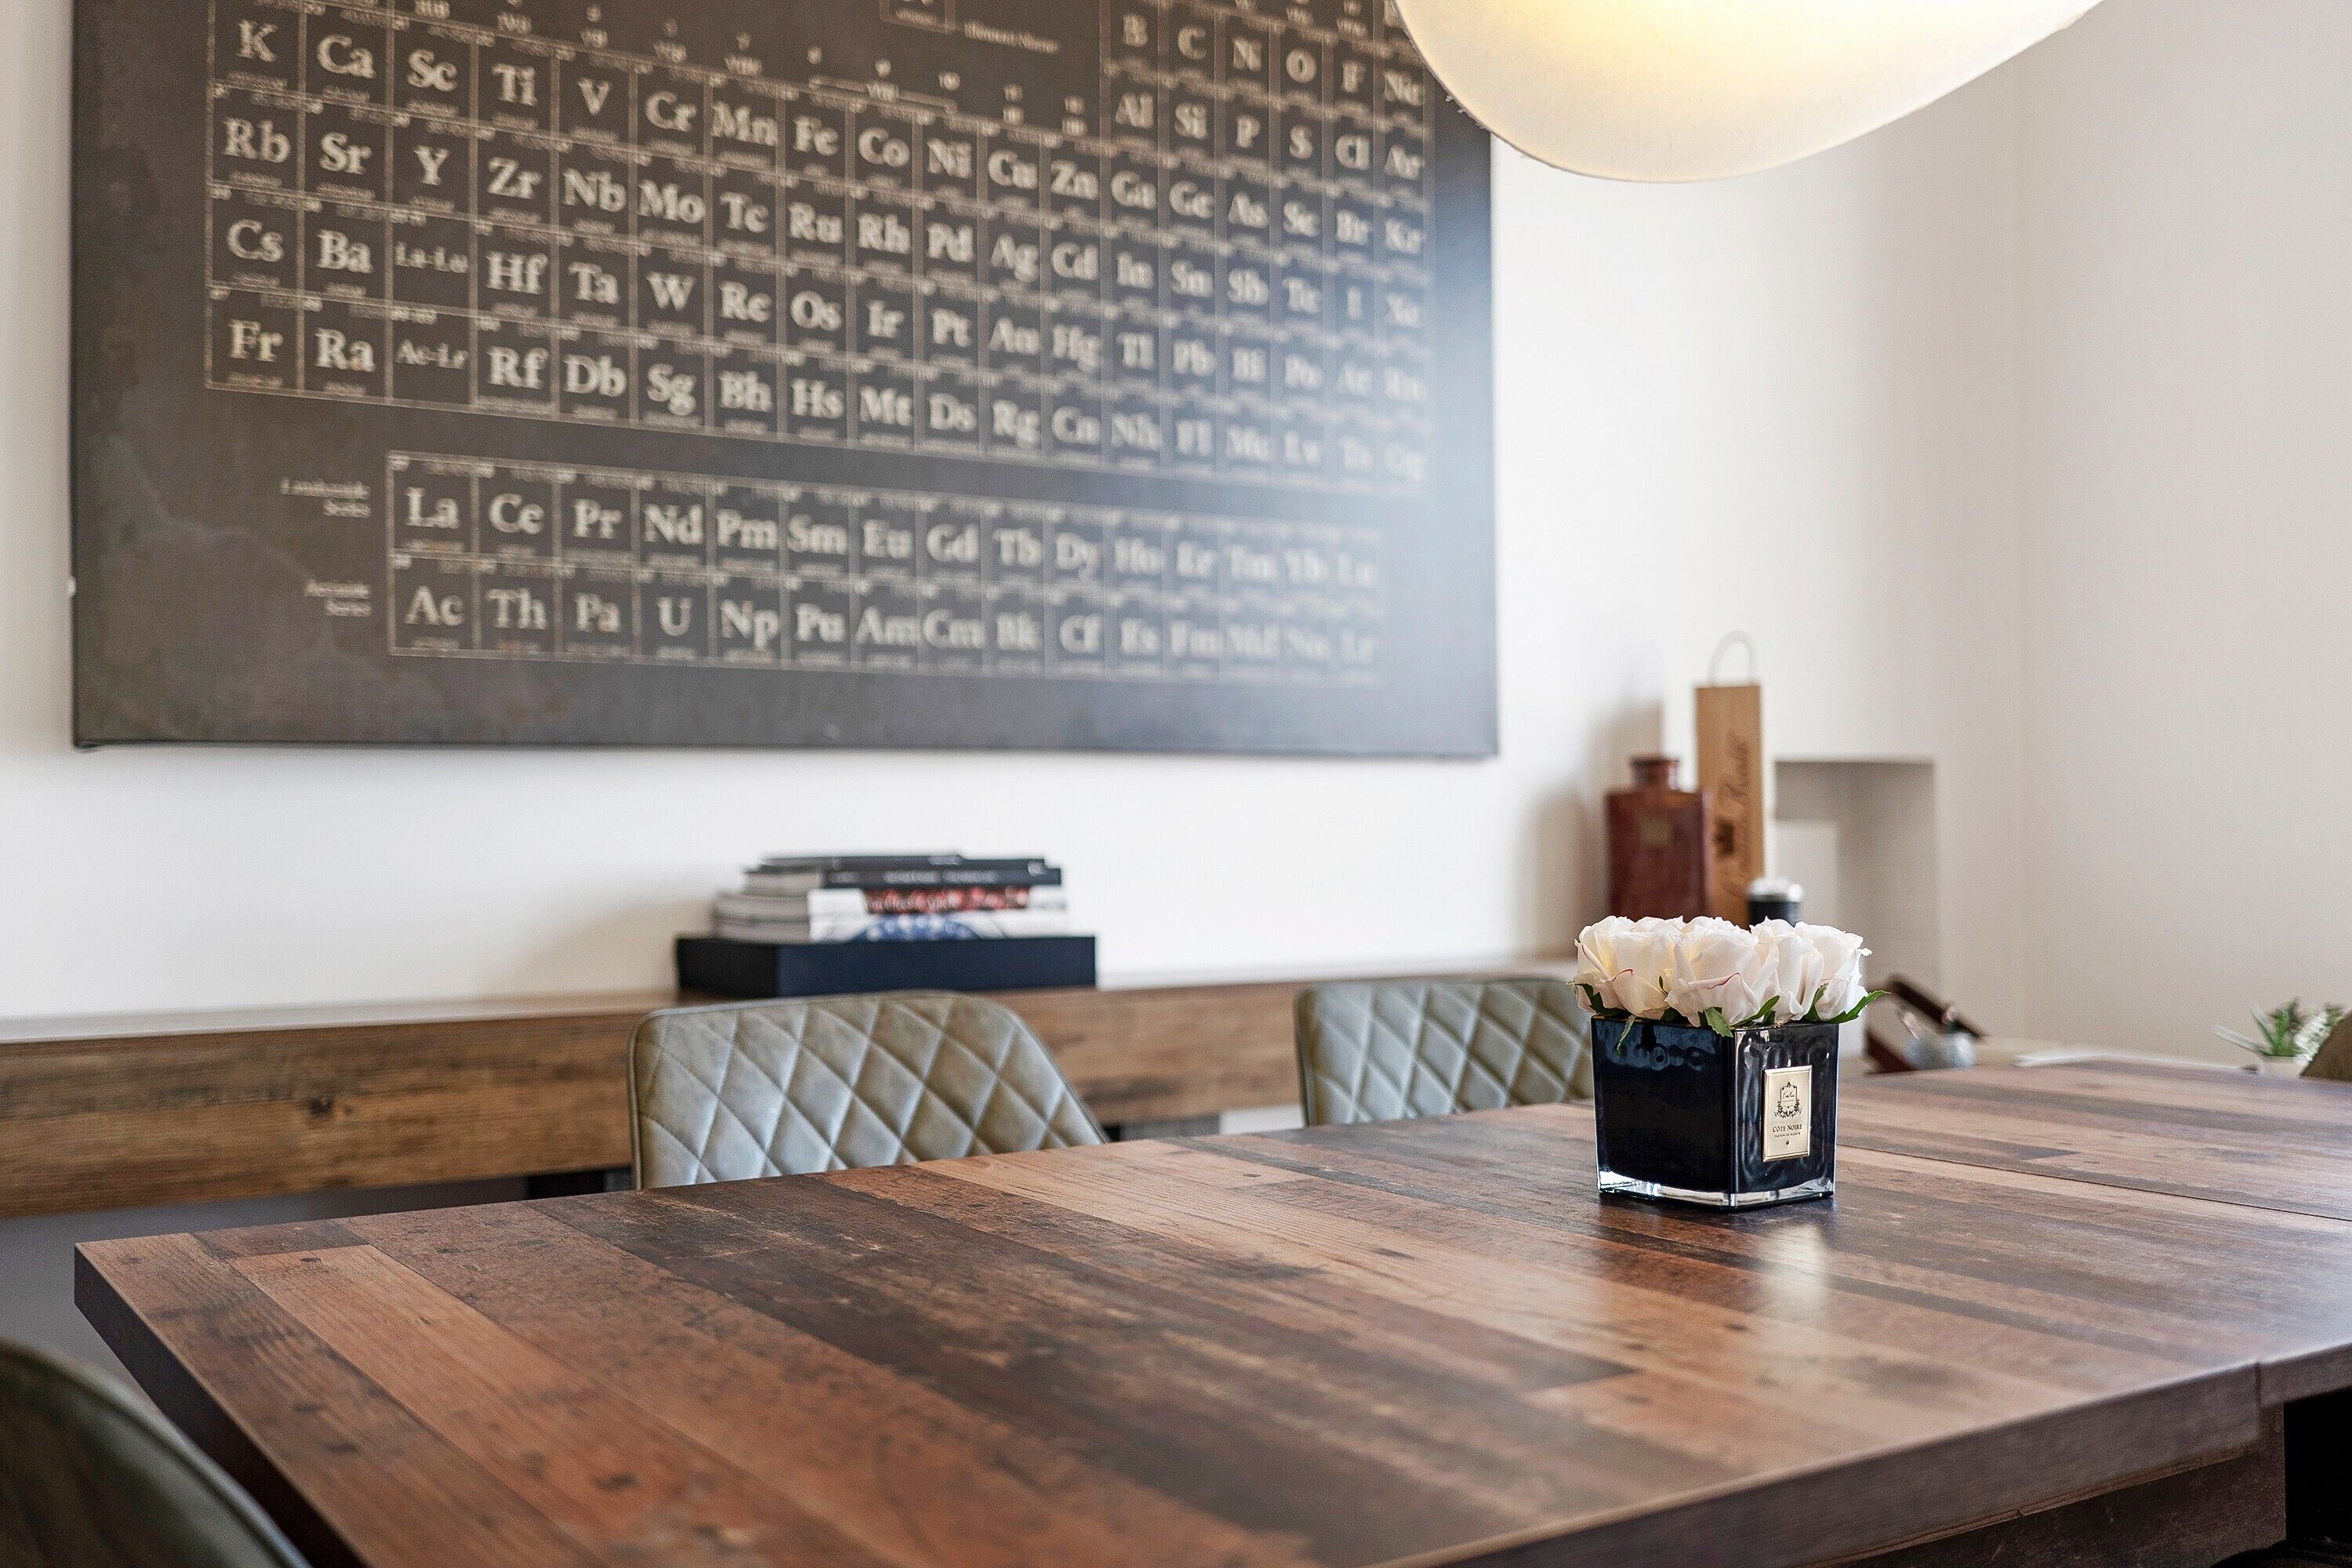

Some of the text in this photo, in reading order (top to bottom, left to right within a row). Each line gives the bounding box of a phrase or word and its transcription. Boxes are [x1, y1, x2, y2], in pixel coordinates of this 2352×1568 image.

[238, 19, 278, 63] K
[317, 35, 375, 78] Ca
[407, 49, 457, 92] Sc
[492, 64, 538, 106] Ti
[577, 78, 610, 114] V
[645, 91, 697, 132] Cr
[712, 100, 777, 146] Mn
[858, 127, 910, 167] Co
[928, 138, 971, 179] Ni
[988, 150, 1038, 189] Cu
[1052, 161, 1098, 200] Zn
[1178, 27, 1208, 60] C
[1286, 49, 1316, 82] O
[1236, 114, 1260, 148] P
[1290, 125, 1313, 158] S
[223, 117, 291, 162] Rb
[320, 132, 372, 174] Sr
[414, 146, 449, 185] Y
[488, 158, 541, 198] Zr
[563, 168, 627, 212] Nb
[639, 180, 706, 223] Mo
[720, 193, 769, 232] Tc
[789, 202, 842, 243] Ru
[858, 213, 911, 253] Rh
[928, 223, 974, 262] Pd
[992, 235, 1040, 281] Ag
[1051, 242, 1099, 281] Cd
[227, 220, 284, 262] Cs
[317, 230, 373, 274] Ba
[486, 252, 548, 294] Hf
[569, 263, 620, 303] Ta
[645, 272, 694, 311] W
[720, 281, 772, 322] Re
[790, 291, 841, 331] Os
[866, 299, 904, 338] Ir
[932, 308, 971, 347] Pt
[229, 320, 283, 362] Fr
[316, 328, 375, 372] Ra
[488, 346, 548, 389] Rf
[563, 355, 627, 397] Db
[647, 364, 697, 416] Sg
[720, 370, 772, 412] Bh
[791, 378, 844, 419] Hs
[860, 386, 913, 426] Mt
[929, 394, 976, 432] Ds
[993, 400, 1040, 447] Rg
[406, 487, 459, 529] La
[489, 493, 545, 535] Ce
[573, 500, 622, 539] Pr
[644, 505, 702, 545] Nd
[717, 510, 778, 550] Pm
[787, 514, 848, 555] Sm
[862, 519, 913, 558] Eu
[926, 524, 979, 563] Gd
[1055, 532, 1102, 581] Dy
[405, 586, 464, 627] Ac
[488, 589, 547, 629] Th
[575, 594, 620, 633] Pa
[658, 597, 691, 636] U
[720, 601, 778, 649] Np
[795, 604, 845, 643] Pu
[856, 607, 922, 644] Am
[922, 608, 987, 650] Cm
